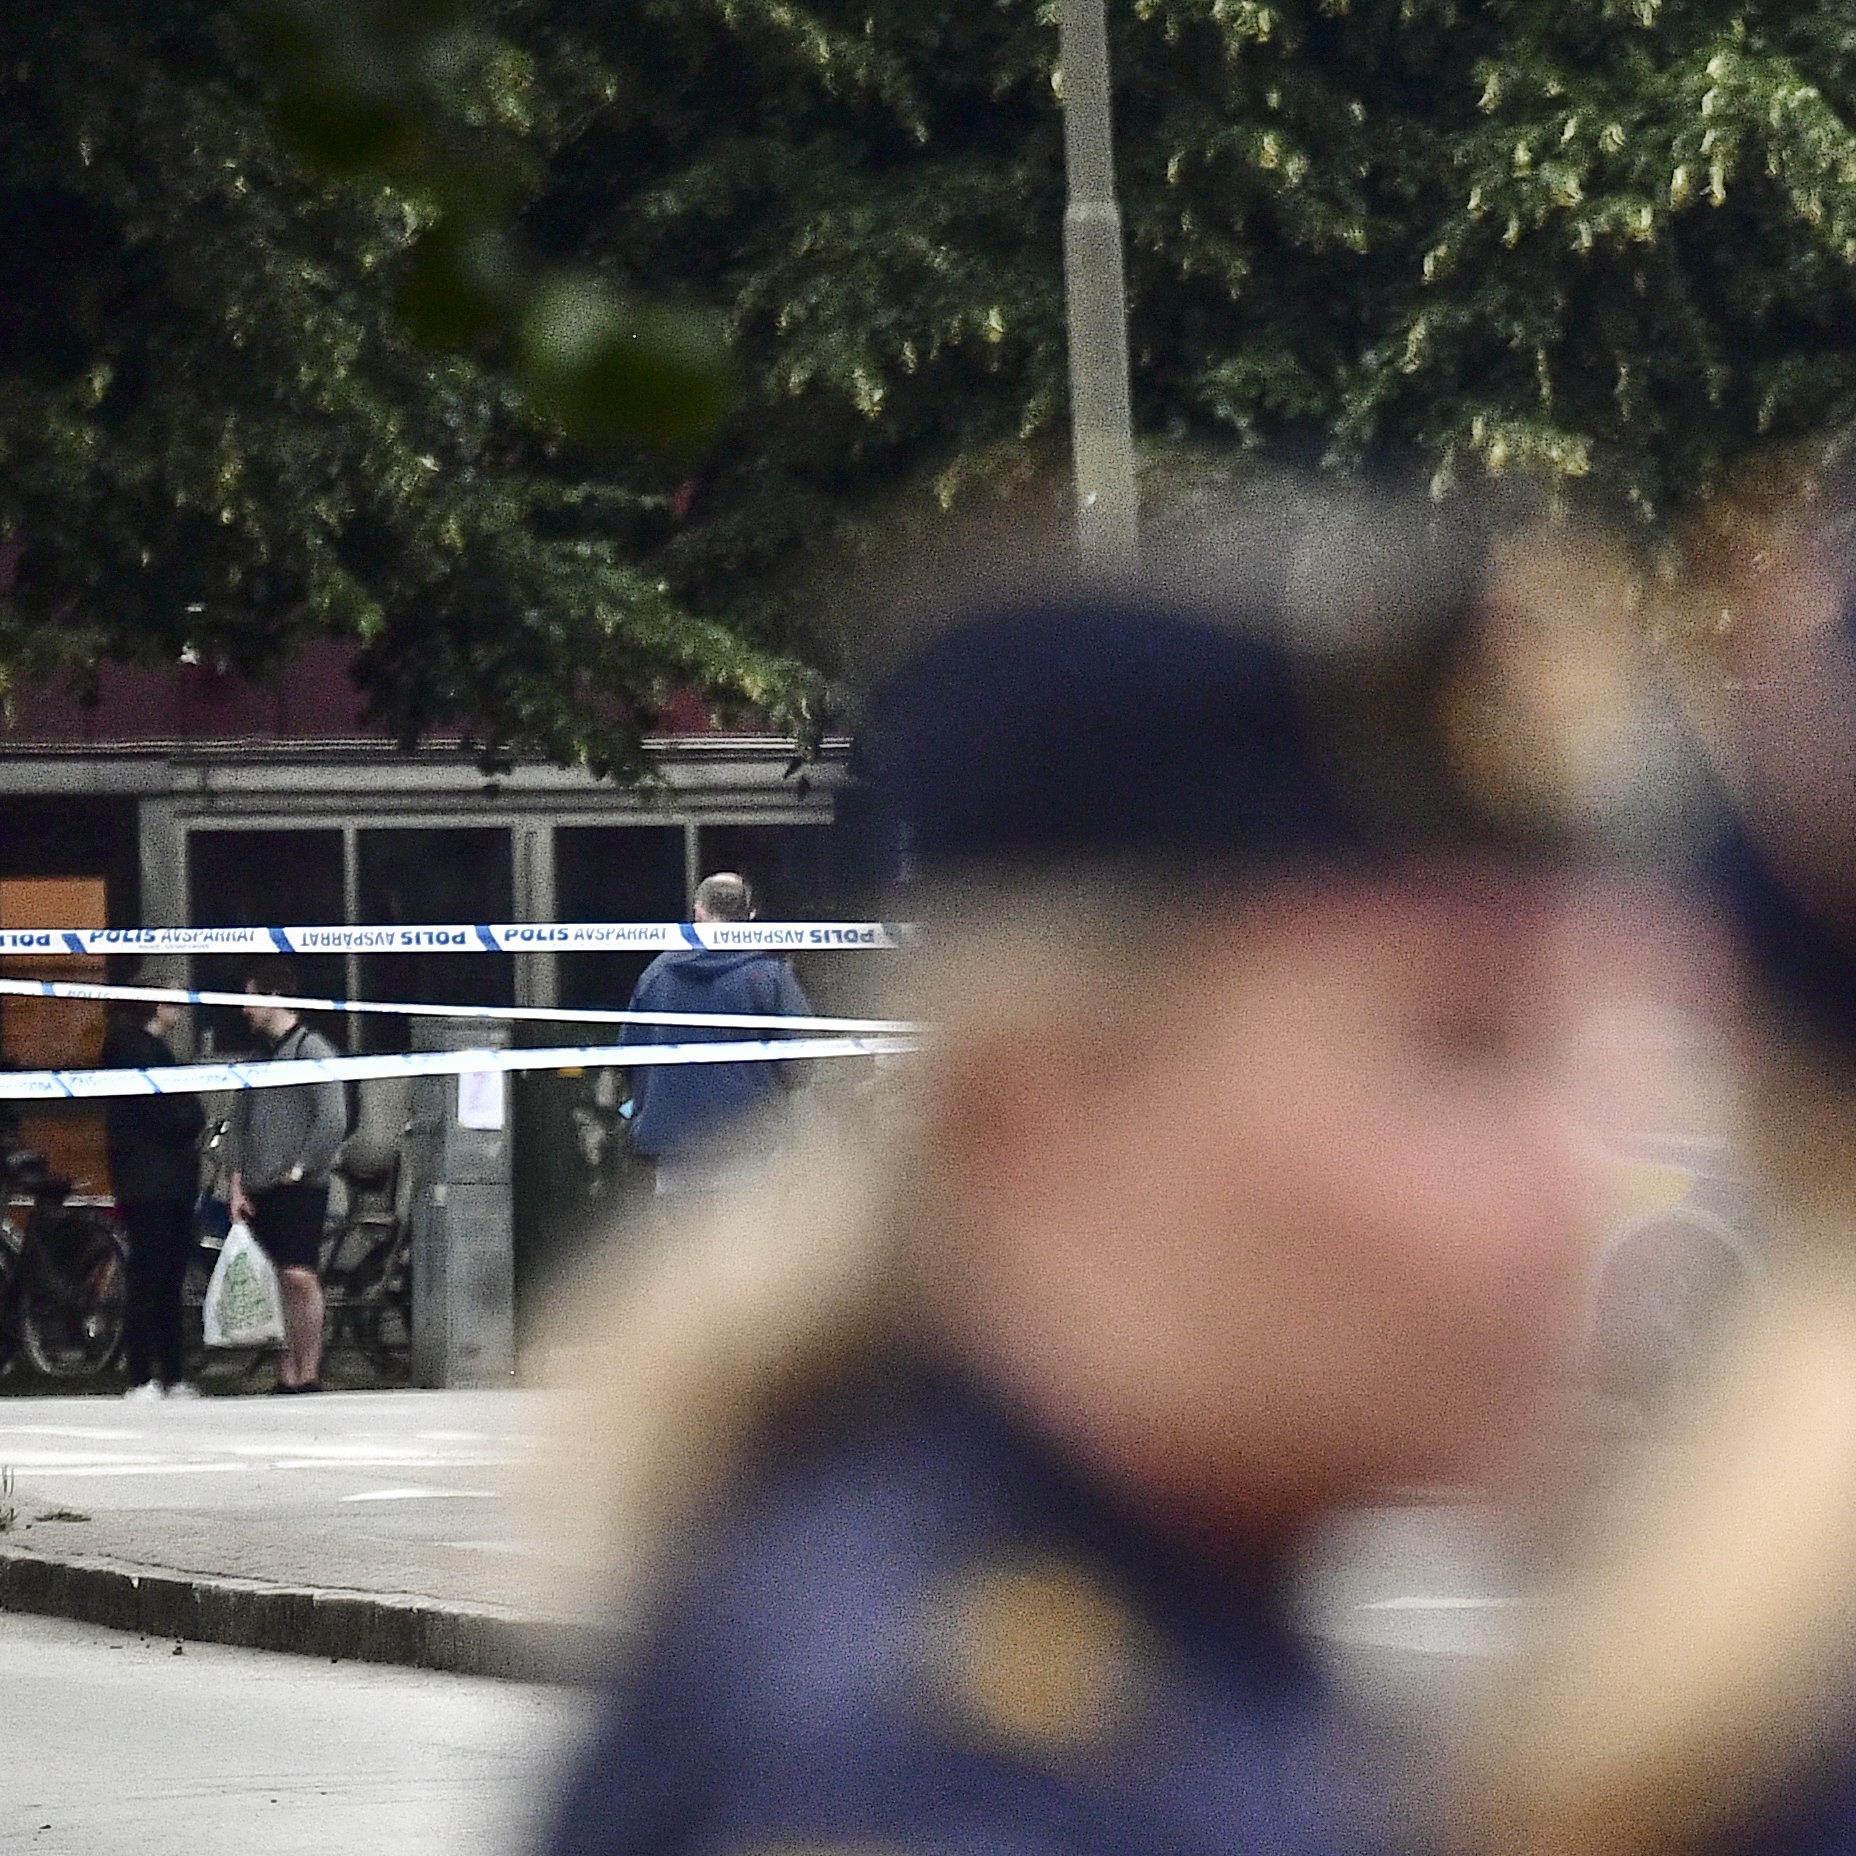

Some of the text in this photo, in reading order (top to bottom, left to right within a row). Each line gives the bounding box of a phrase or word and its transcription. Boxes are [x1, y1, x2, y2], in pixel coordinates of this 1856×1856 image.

[0, 934, 51, 947] POLI
[89, 929, 156, 943] POLIS
[400, 931, 467, 946] POLIS
[504, 928, 569, 942] POLIS
[809, 929, 875, 944] POLIS
